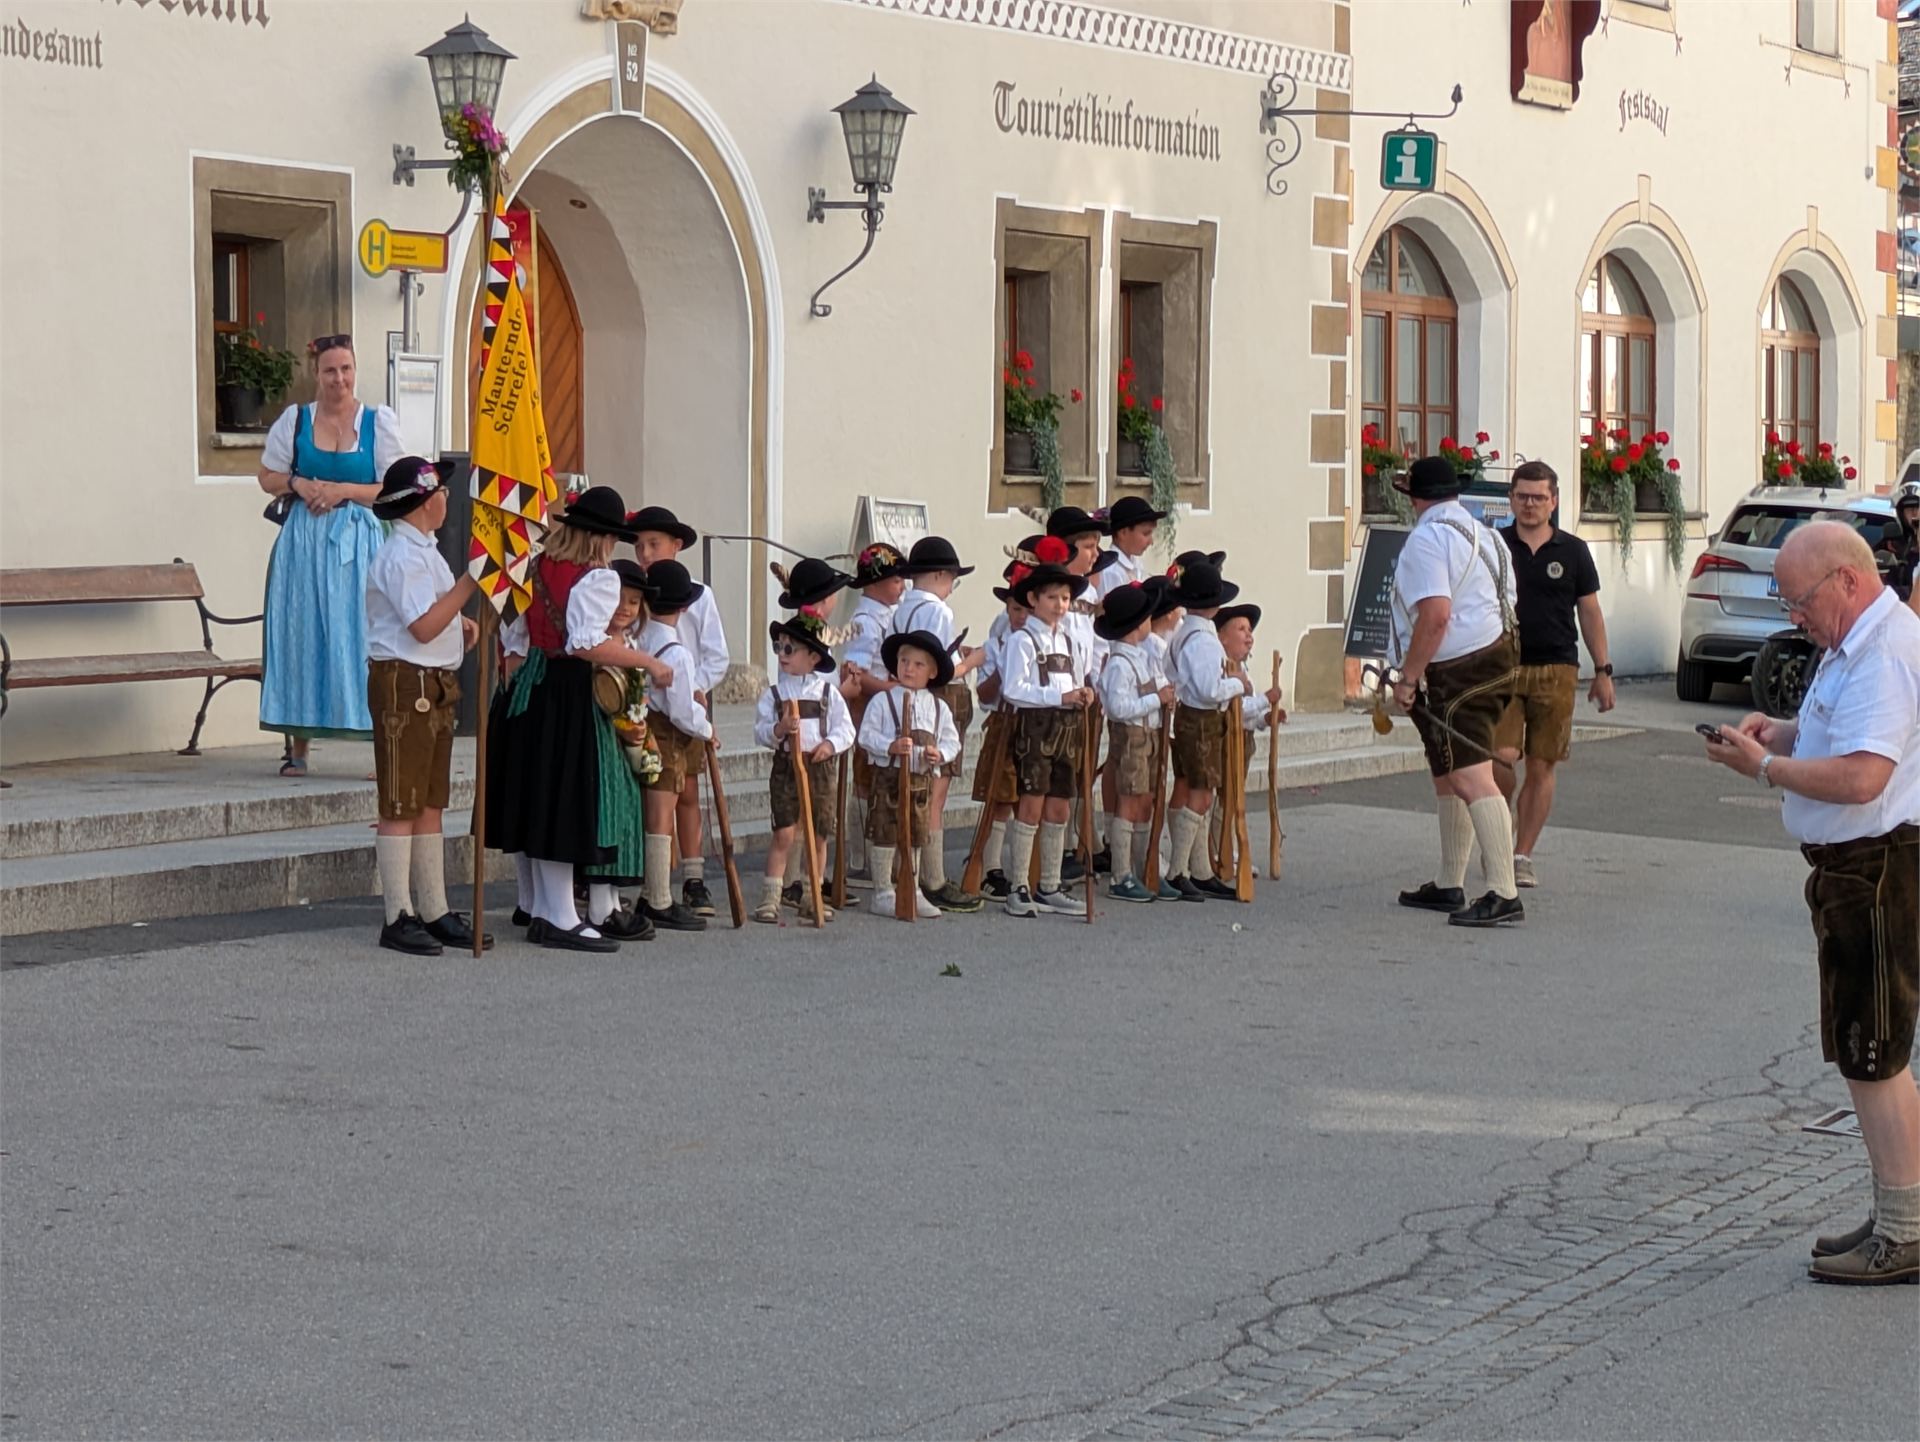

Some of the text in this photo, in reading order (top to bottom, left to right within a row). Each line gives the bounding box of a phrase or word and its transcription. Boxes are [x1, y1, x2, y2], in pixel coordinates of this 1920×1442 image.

[0, 16, 103, 69] ndesamt
[626, 61, 639, 82] 52
[993, 80, 1221, 162] Touristikinformation
[1619, 88, 1669, 137] Festsaal
[1394, 139, 1421, 184] i
[368, 229, 386, 266] H
